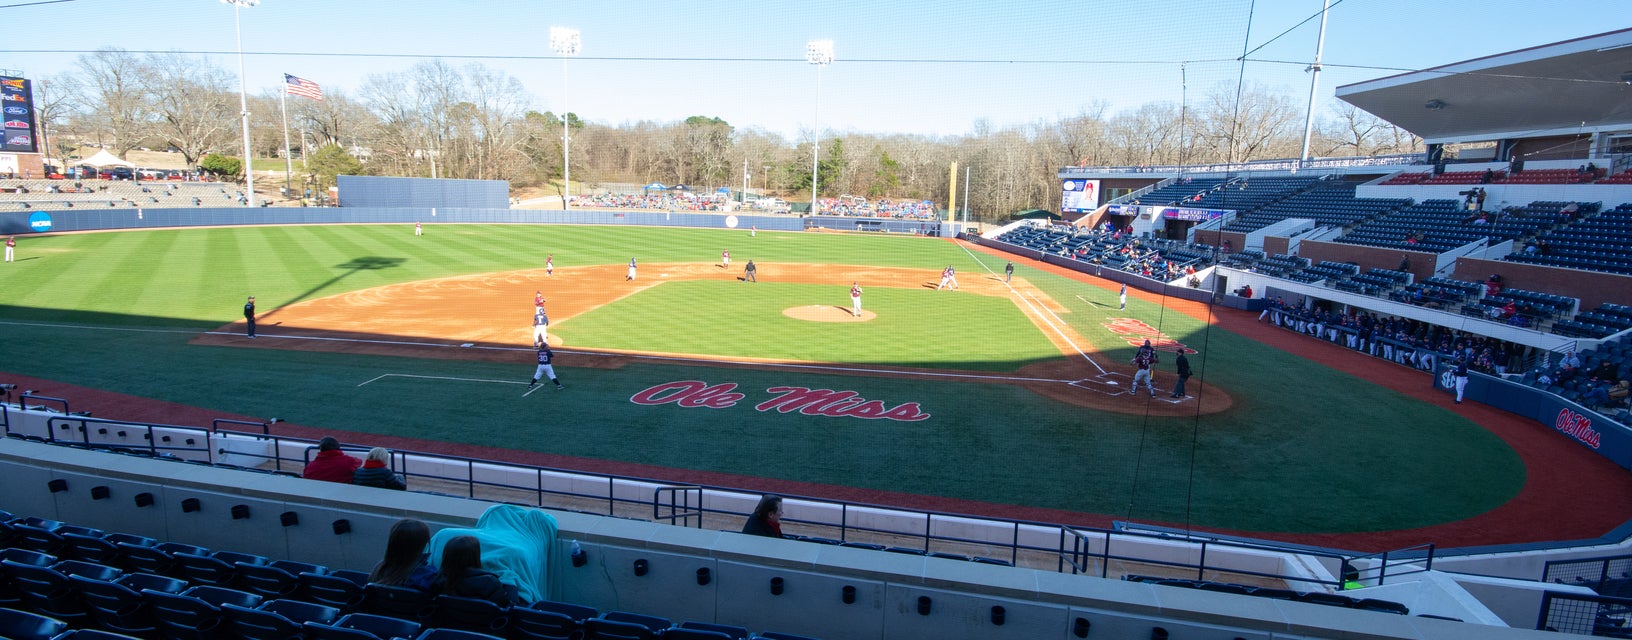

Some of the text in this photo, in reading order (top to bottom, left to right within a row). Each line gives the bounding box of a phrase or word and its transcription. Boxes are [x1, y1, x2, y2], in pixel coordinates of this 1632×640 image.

[2, 93, 25, 102] FedEx
[630, 380, 931, 422] Ole Miss
[1555, 407, 1601, 450] Ole Miss
